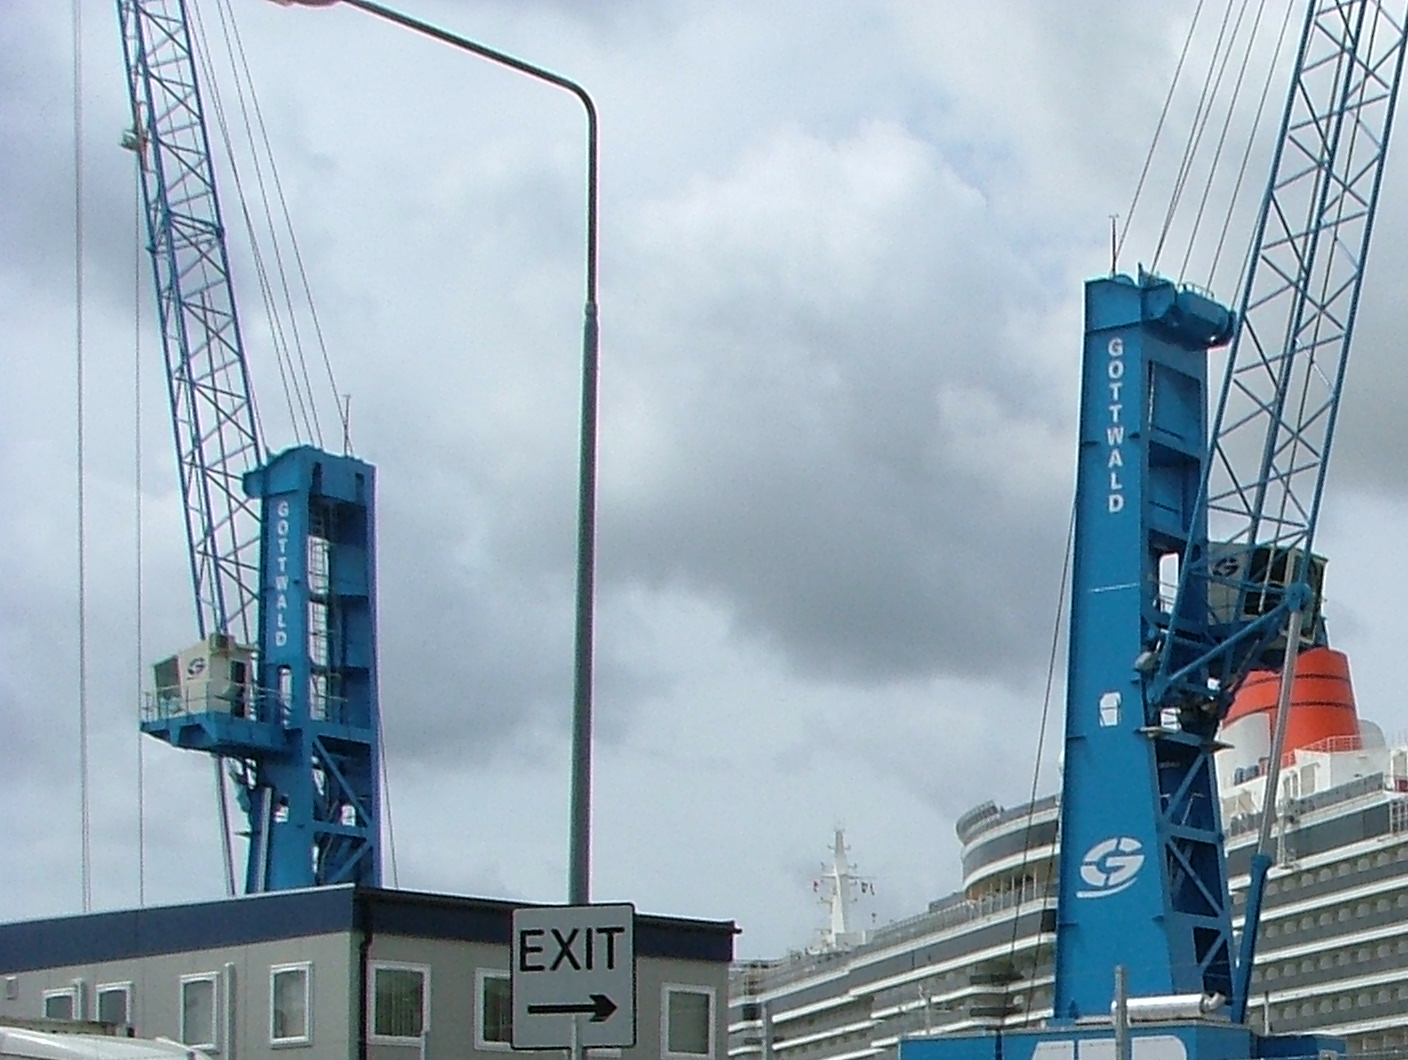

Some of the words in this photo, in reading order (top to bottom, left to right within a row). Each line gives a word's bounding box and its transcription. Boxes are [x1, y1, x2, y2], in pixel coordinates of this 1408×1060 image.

[1107, 337, 1125, 513] GOTTWALD
[275, 501, 290, 647] GOTTWALD
[519, 926, 626, 972] EXIT
